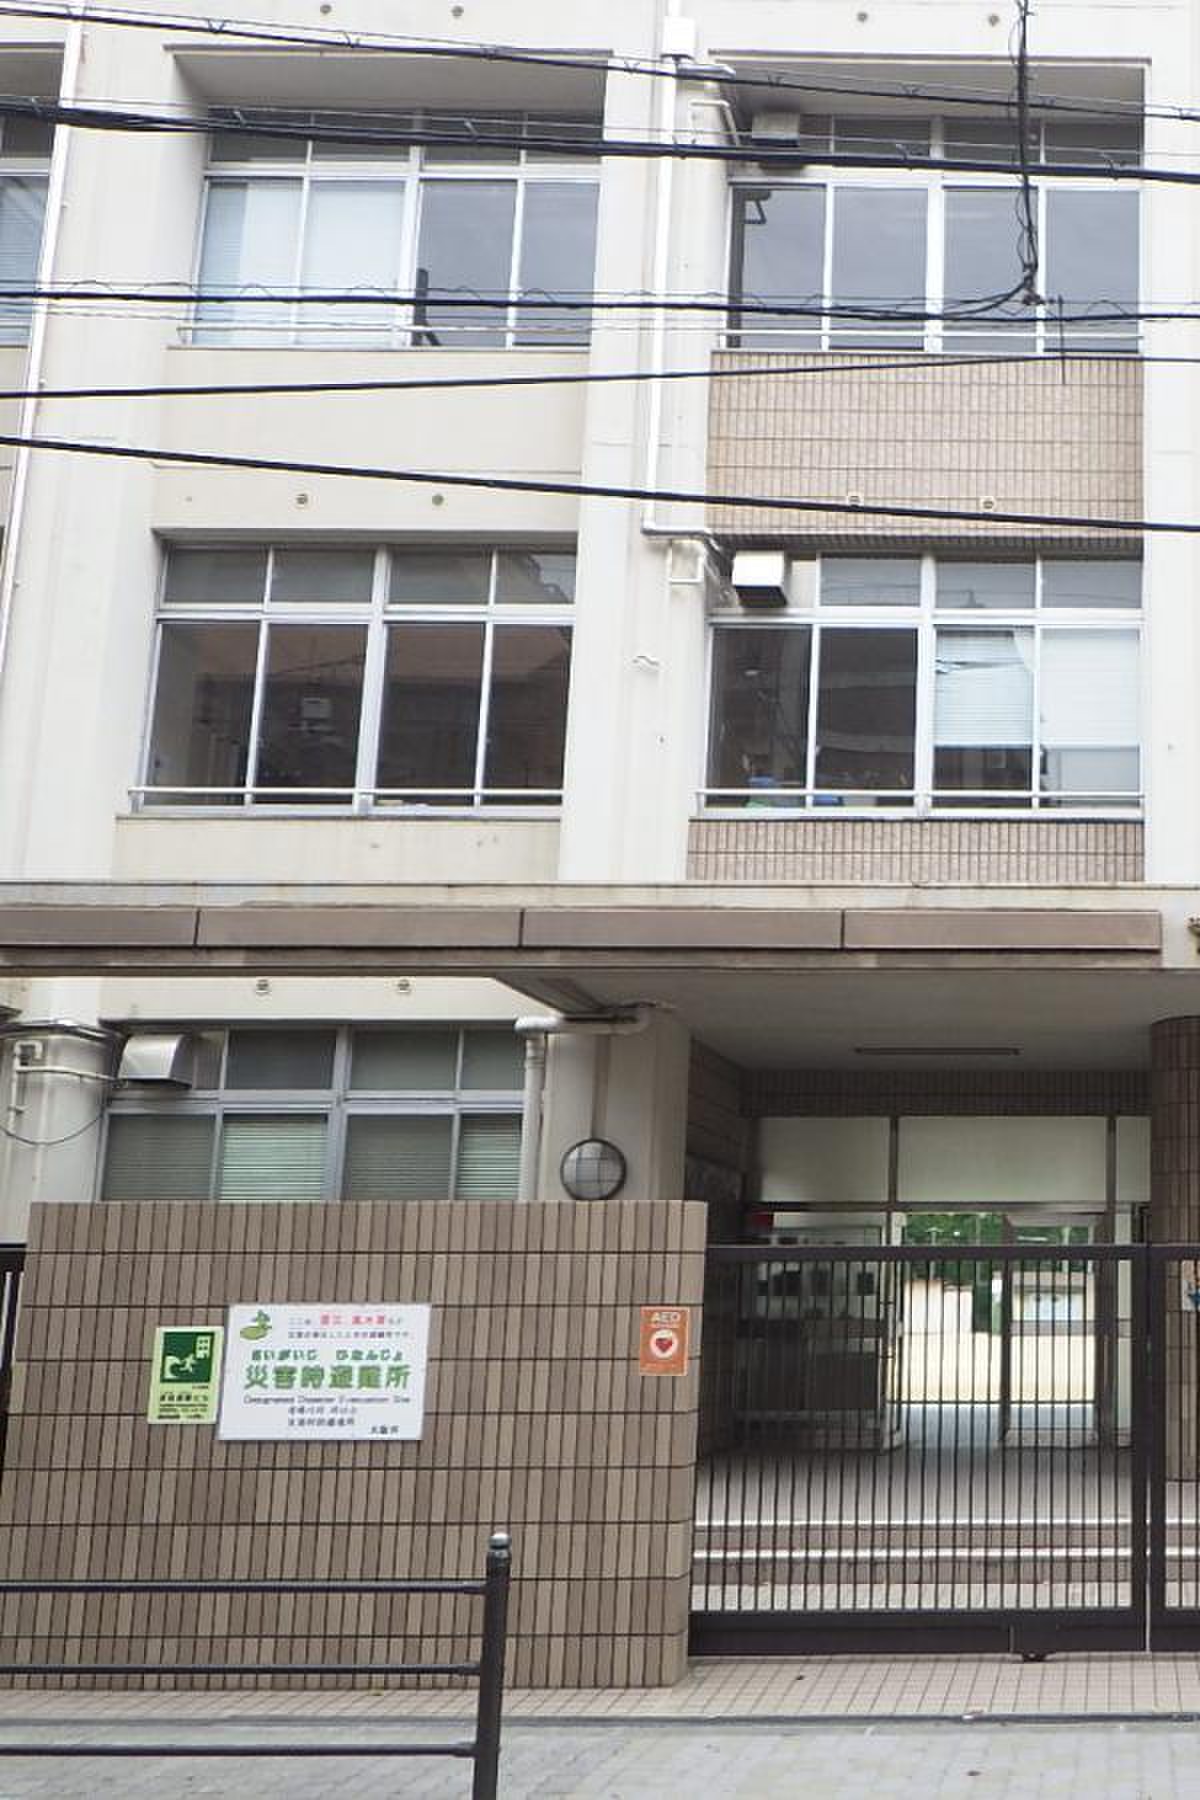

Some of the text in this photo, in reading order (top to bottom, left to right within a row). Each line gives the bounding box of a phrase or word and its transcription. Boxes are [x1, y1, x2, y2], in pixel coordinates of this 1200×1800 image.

[651, 1311, 681, 1323] AED
[243, 1364, 410, 1390] 災害時避難所
